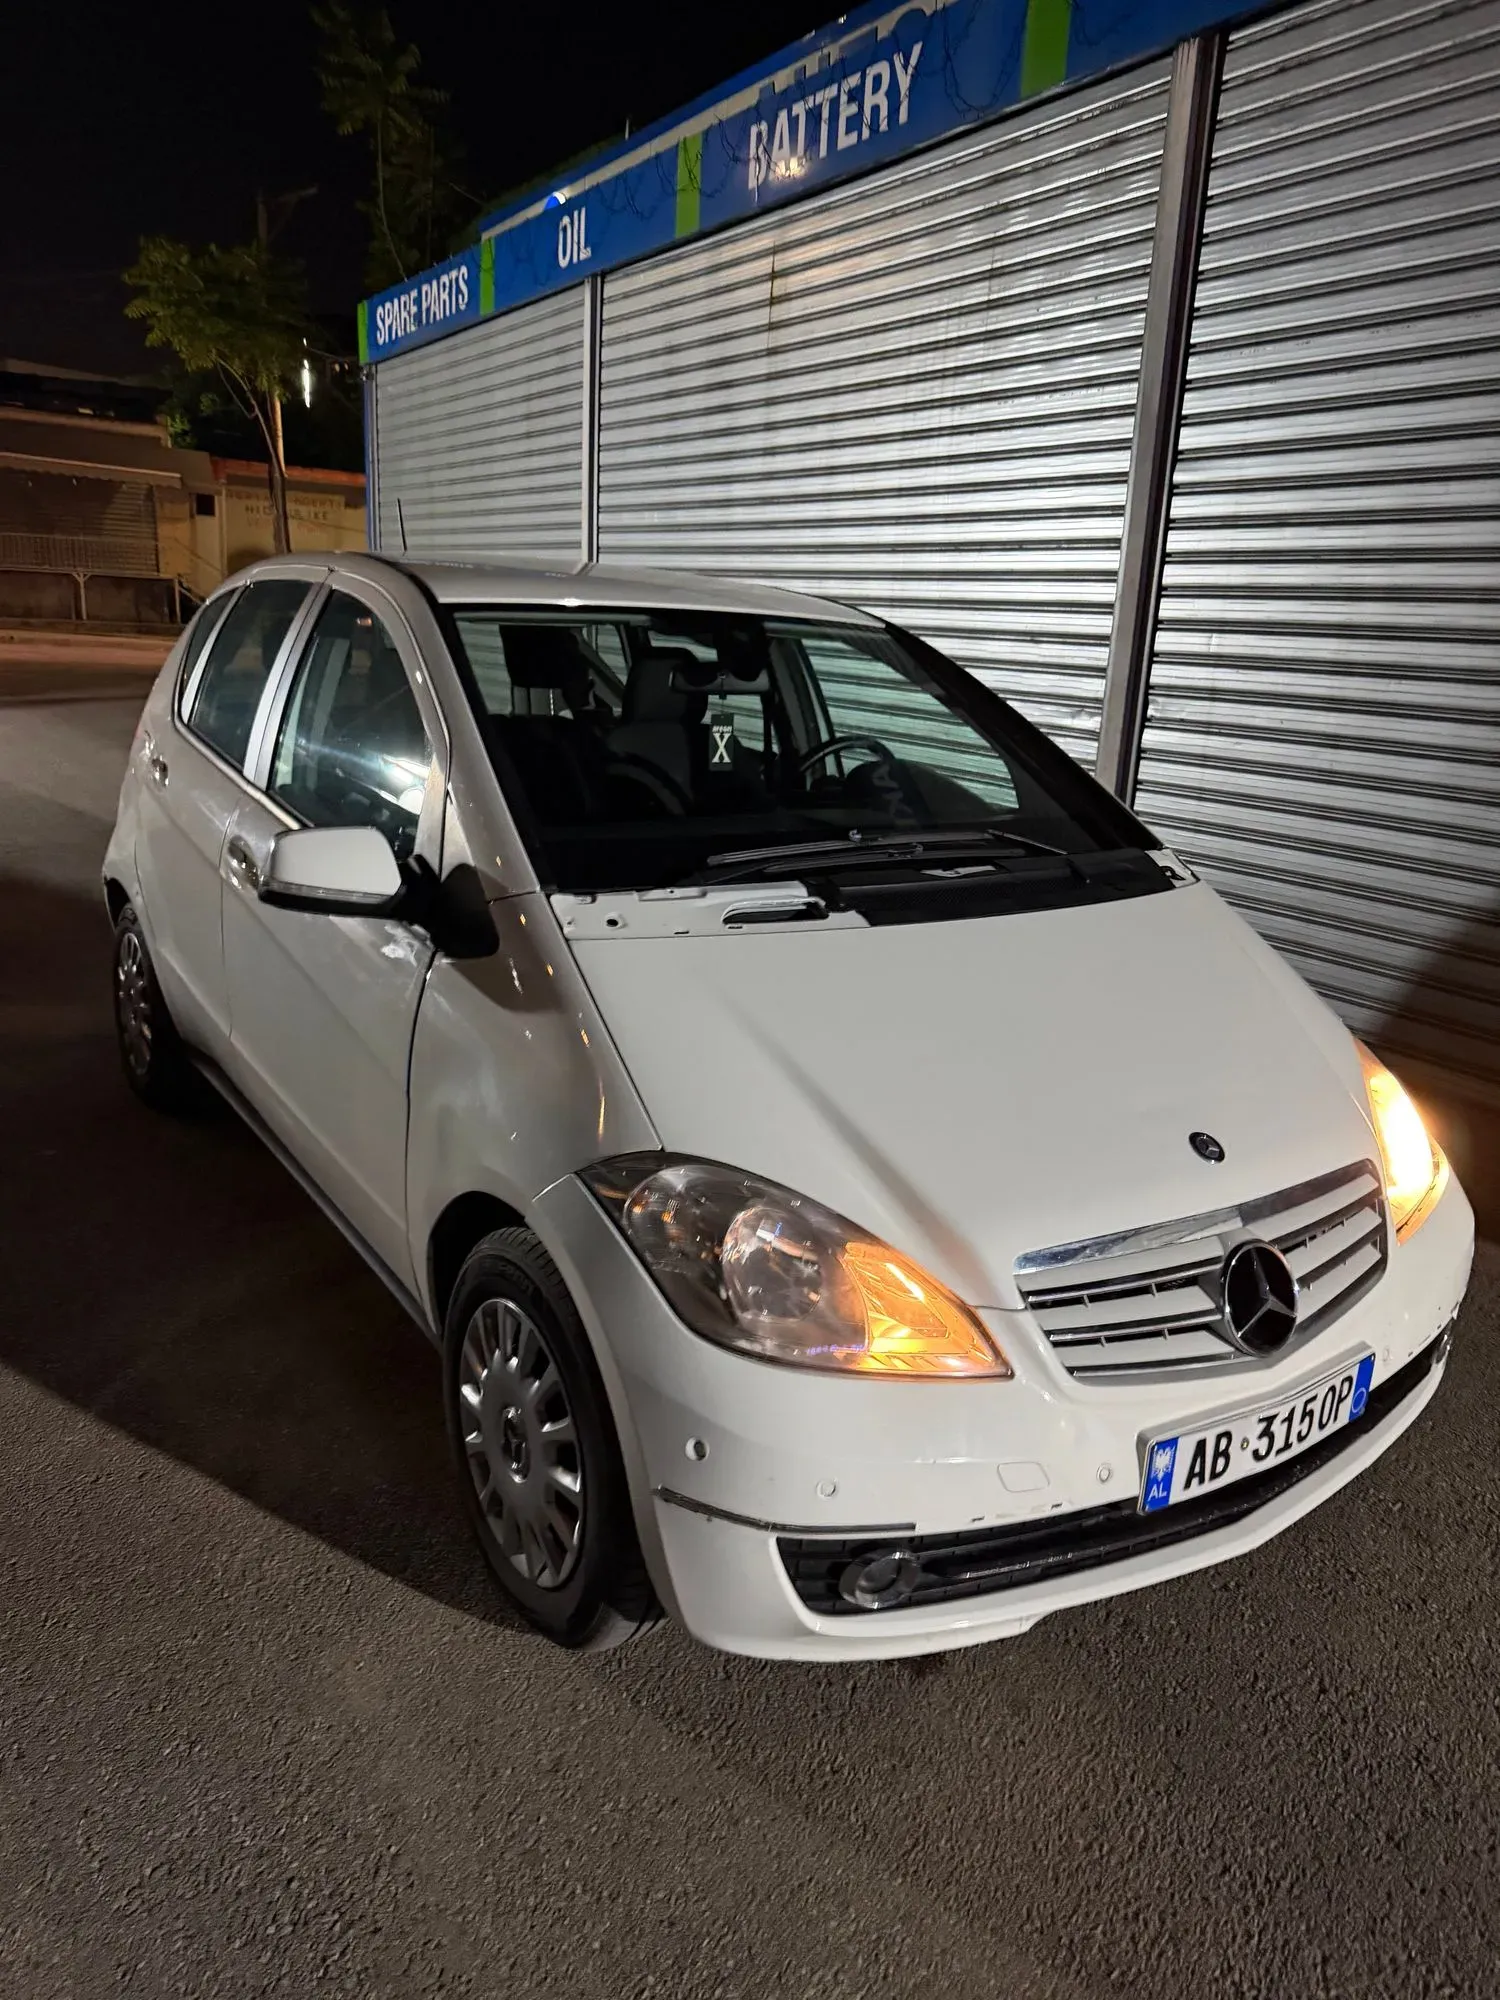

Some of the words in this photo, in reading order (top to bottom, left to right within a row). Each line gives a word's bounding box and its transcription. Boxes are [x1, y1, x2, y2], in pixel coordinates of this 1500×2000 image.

[748, 41, 923, 191] BATTERY
[557, 207, 592, 269] OIL
[376, 288, 418, 345] SPARE
[421, 265, 469, 325] PARTS
[711, 732, 732, 763] X
[1183, 1430, 1233, 1491] AB
[1148, 1484, 1168, 1501] AL
